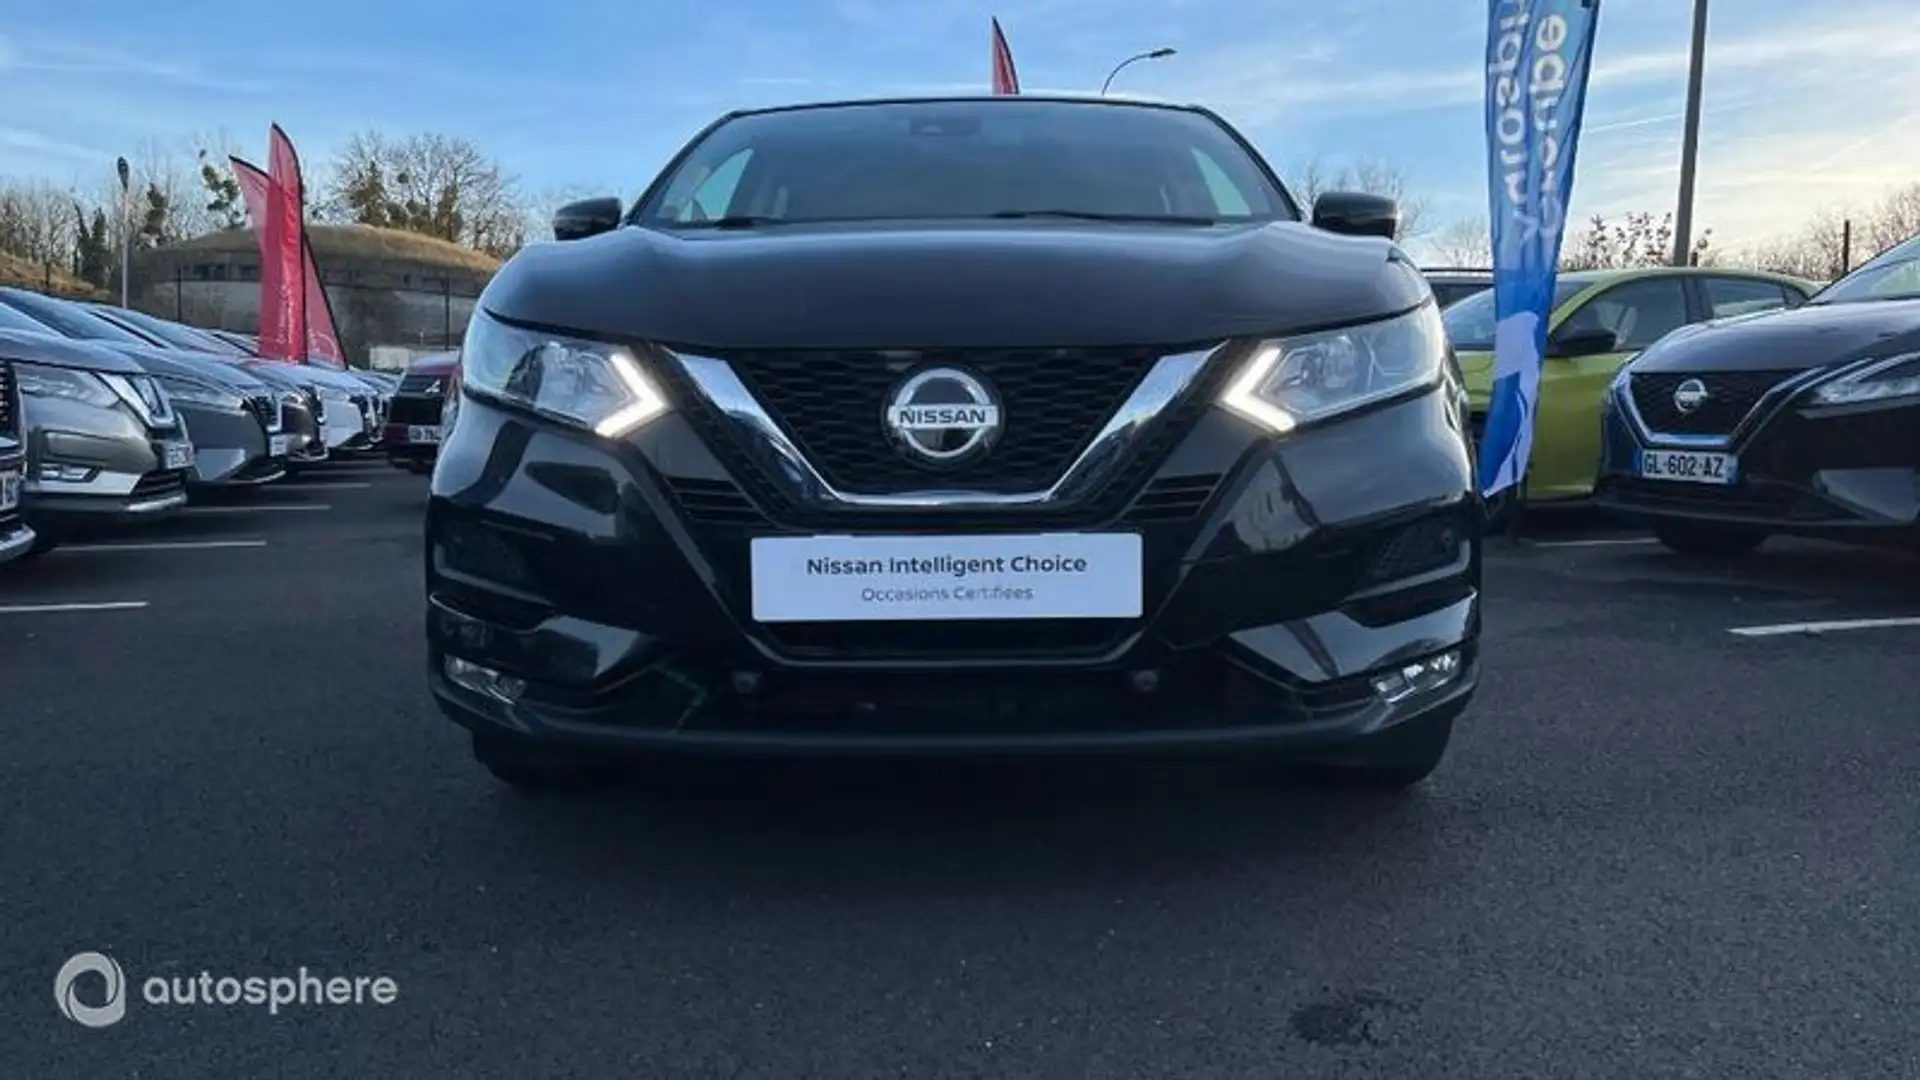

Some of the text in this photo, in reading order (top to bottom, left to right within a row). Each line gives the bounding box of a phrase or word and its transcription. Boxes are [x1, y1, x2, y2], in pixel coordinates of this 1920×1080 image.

[900, 409, 985, 424] NISSAN
[1643, 452, 1725, 479] GL-602-AZ
[806, 553, 1088, 578] Nissan Intelligent Choice
[860, 587, 949, 602] Occasions
